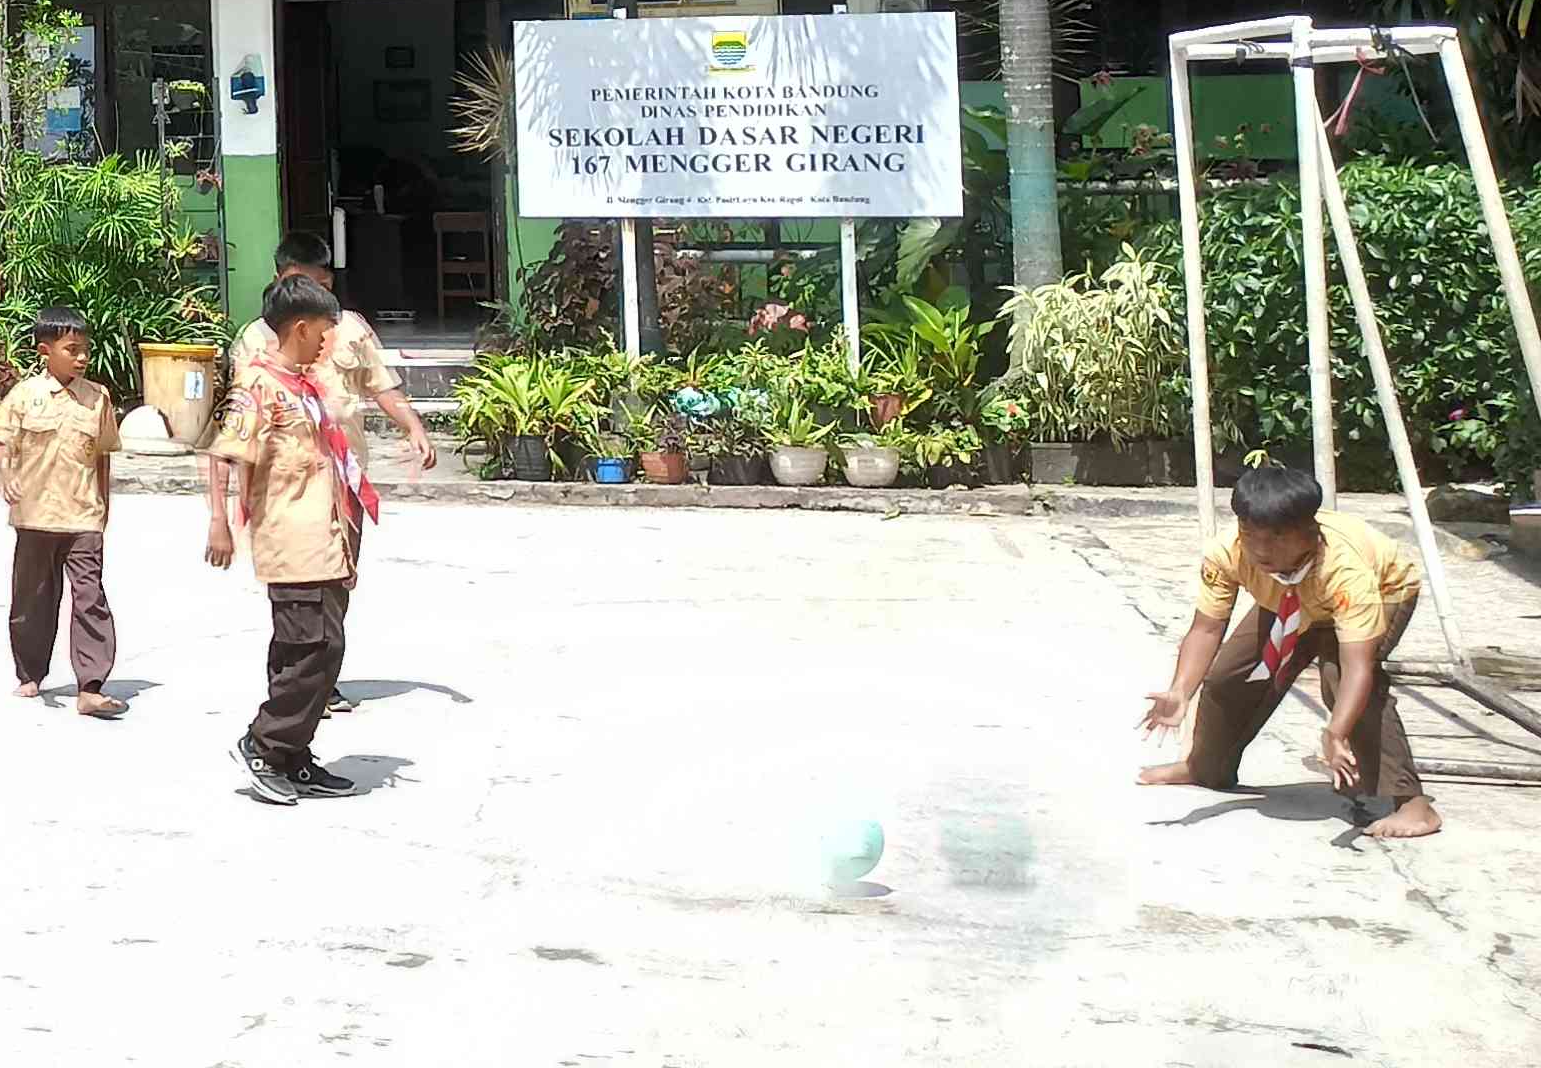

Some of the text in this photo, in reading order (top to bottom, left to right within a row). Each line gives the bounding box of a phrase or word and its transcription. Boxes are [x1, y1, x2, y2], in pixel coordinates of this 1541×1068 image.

[591, 84, 879, 102] PEMERINTAH KOTA BANDUNG
[641, 103, 828, 119] DINAS PENDIDIKAN
[548, 123, 925, 148] SEKOLAH DASAR NEGERI
[572, 151, 906, 175] 167 MENGGER GIRANG
